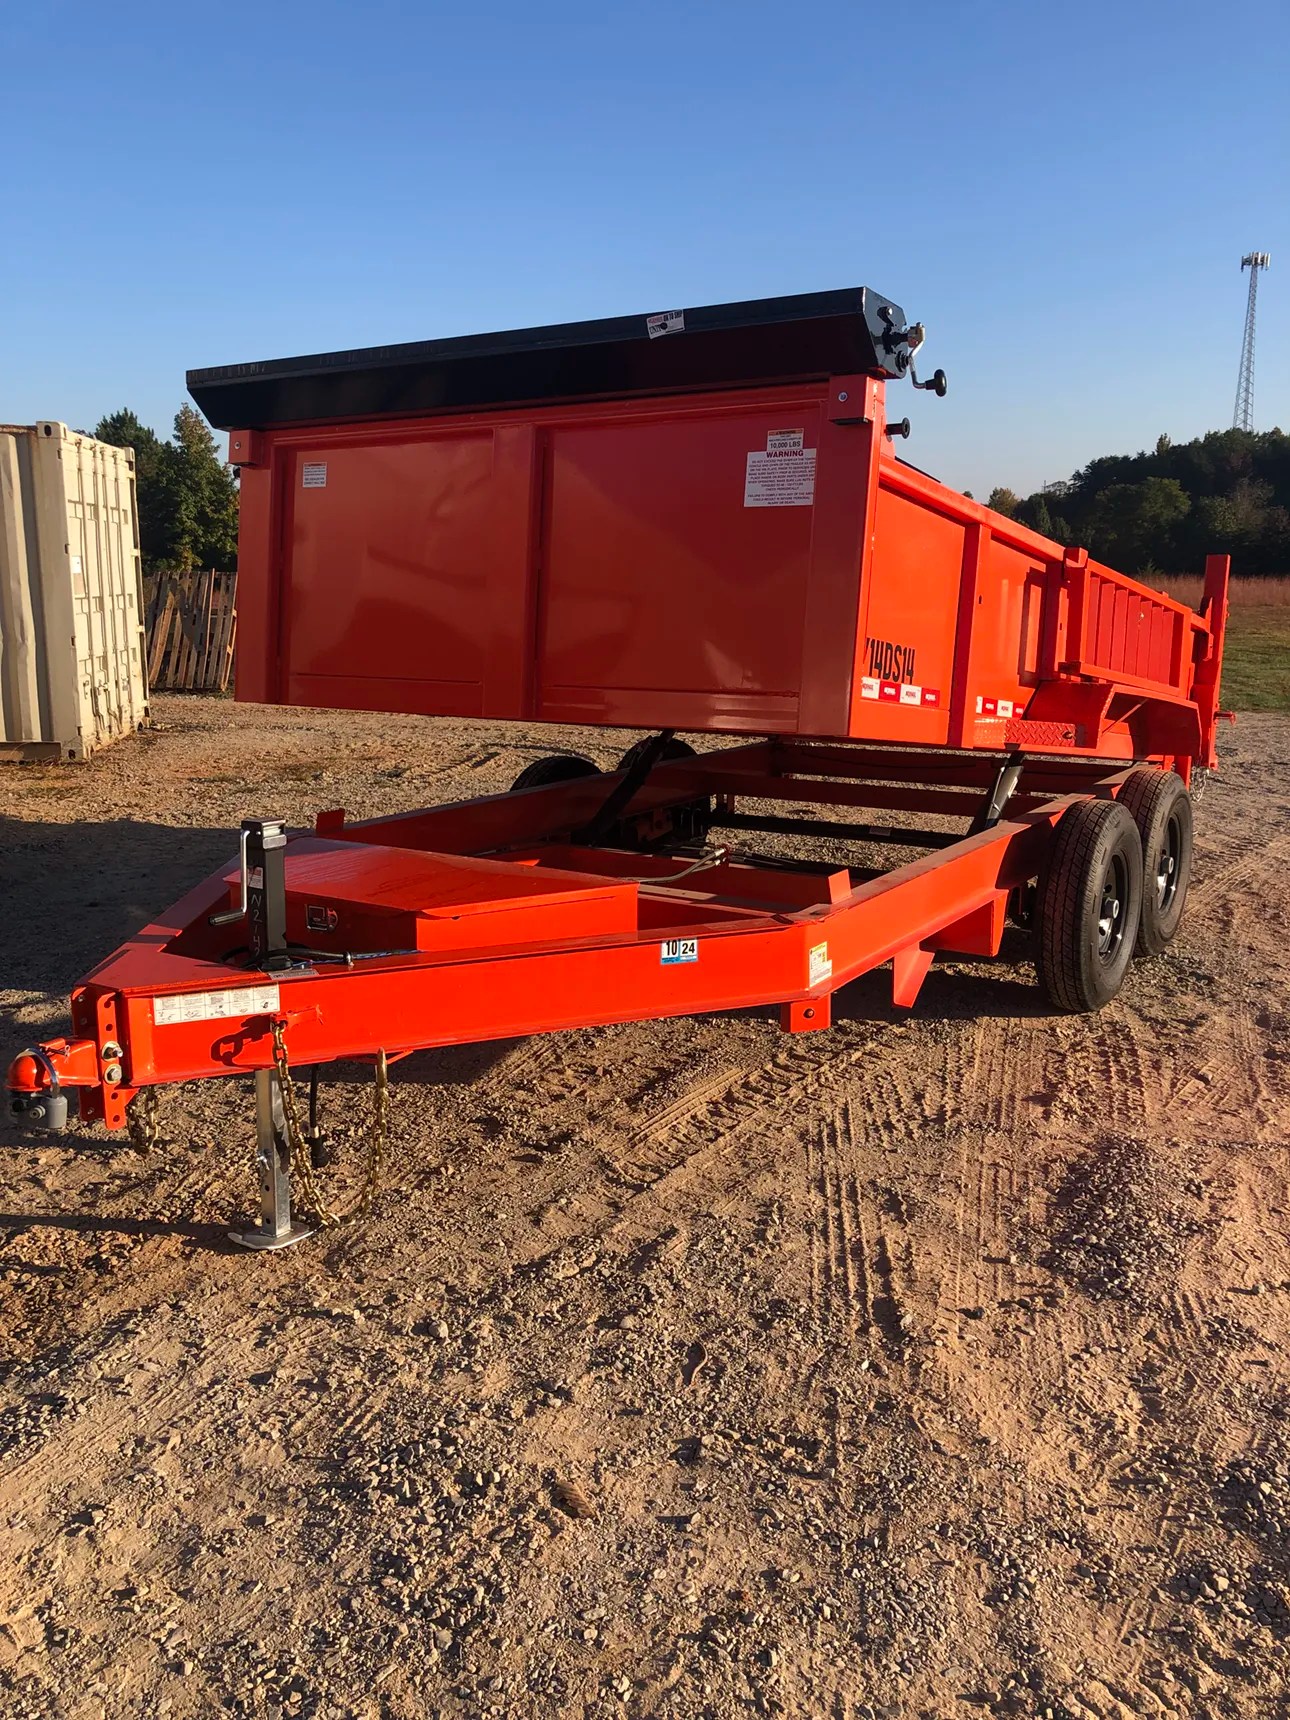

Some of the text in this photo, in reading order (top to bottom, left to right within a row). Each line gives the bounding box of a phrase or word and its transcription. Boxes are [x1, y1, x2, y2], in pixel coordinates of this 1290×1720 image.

[789, 440, 801, 448] LBS
[766, 450, 804, 458] WARNING
[666, 940, 696, 956] 10 24
